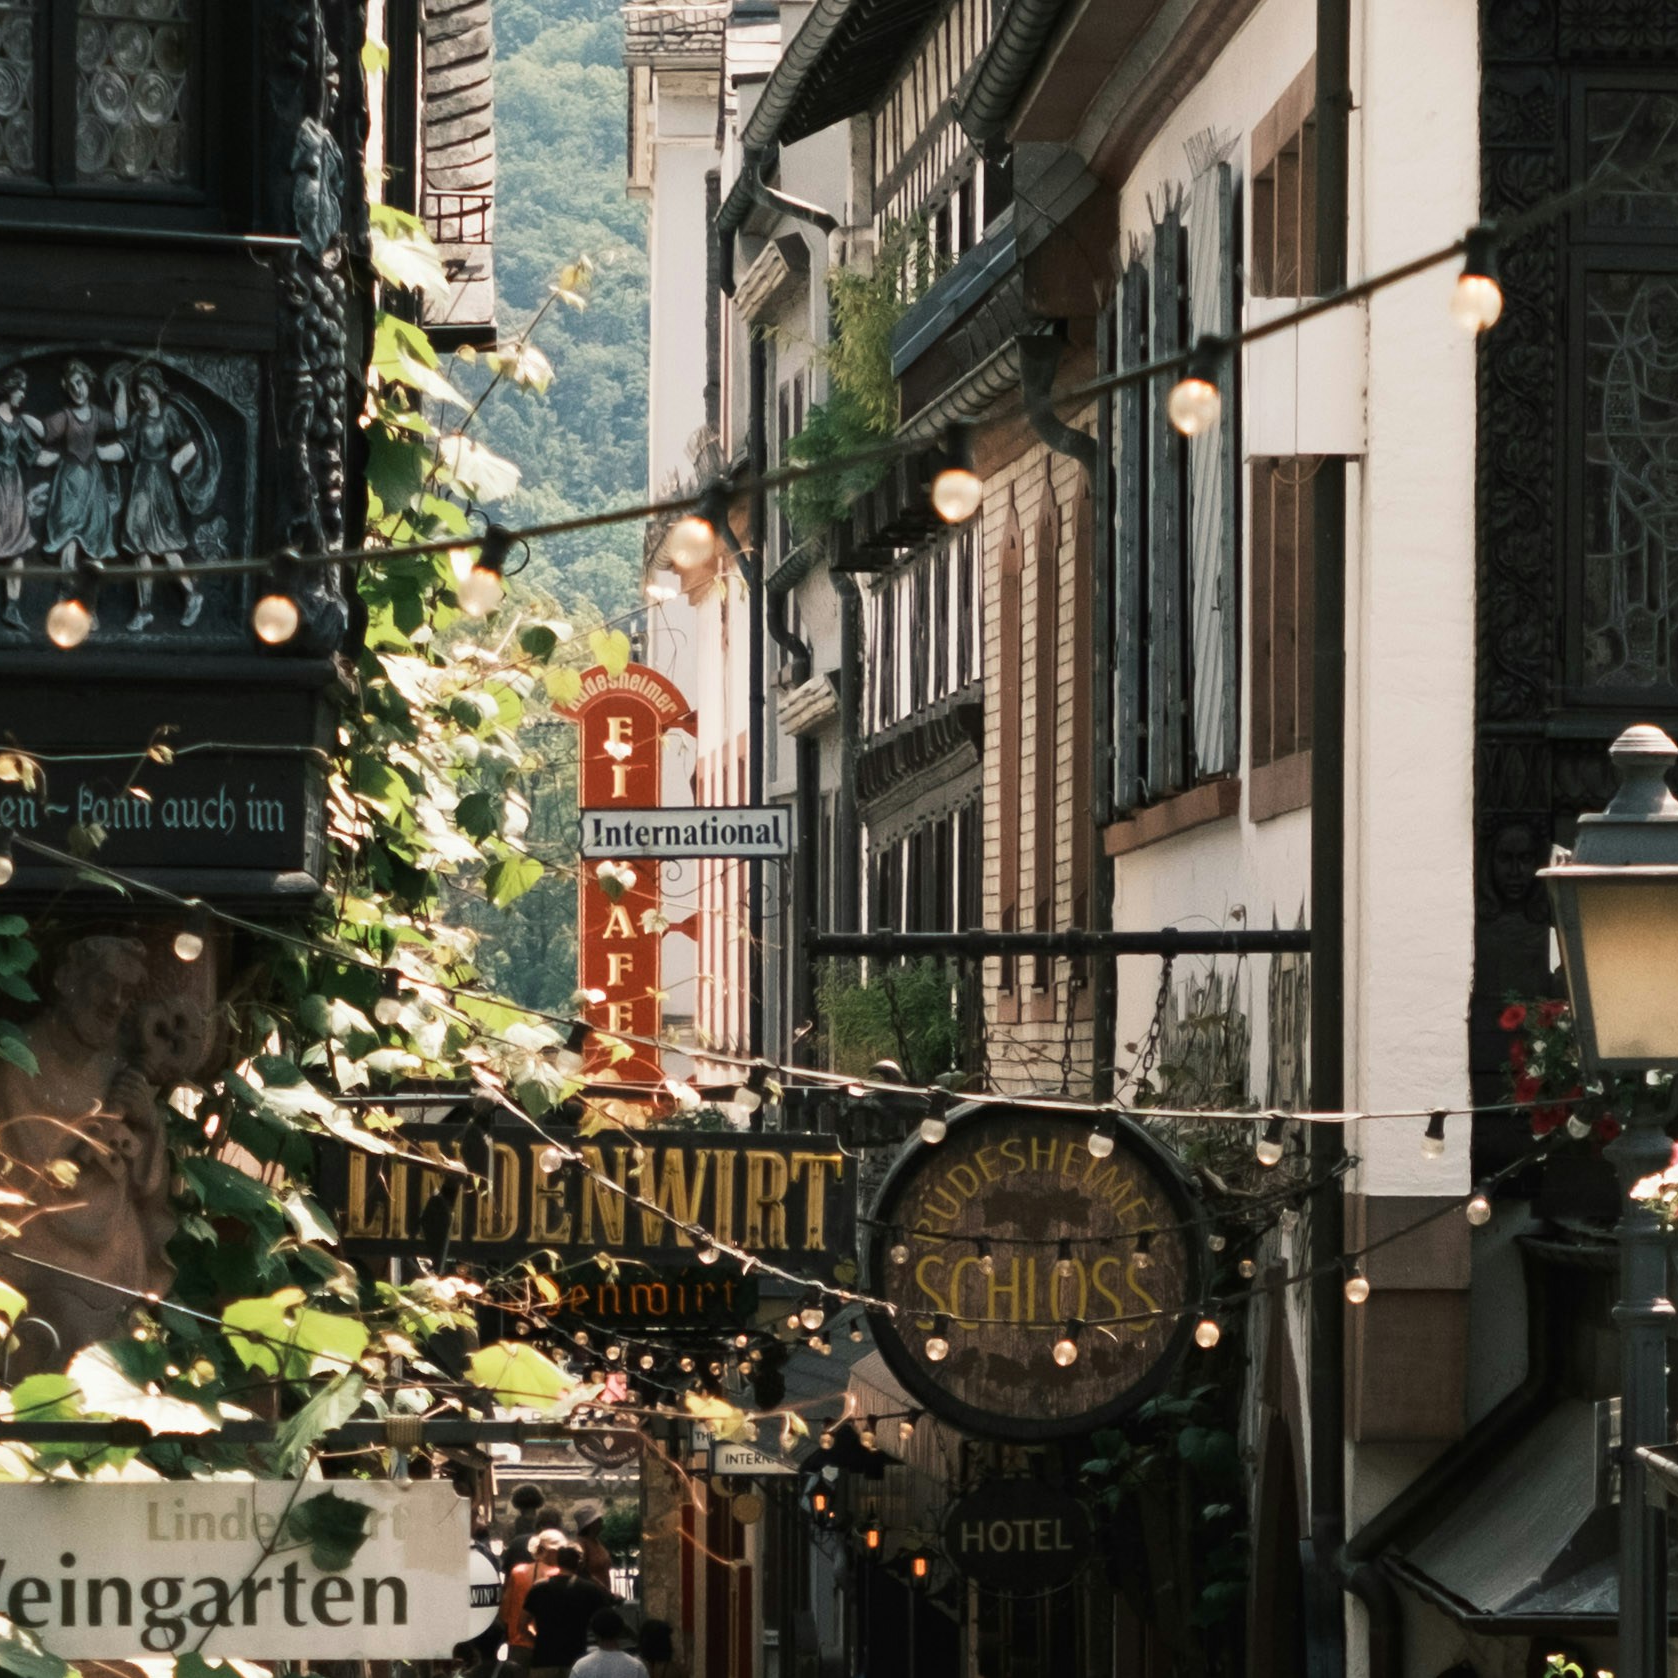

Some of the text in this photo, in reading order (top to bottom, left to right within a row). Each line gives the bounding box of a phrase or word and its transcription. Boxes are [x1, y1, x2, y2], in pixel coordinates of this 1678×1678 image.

[567, 671, 677, 713] desheimer
[161, 785, 236, 834] auch
[247, 784, 286, 832] im
[592, 815, 784, 850] International
[915, 1253, 1158, 1333] SCHLOSS
[146, 1498, 409, 1541] Lindert
[960, 1518, 1074, 1553] HOTEL
